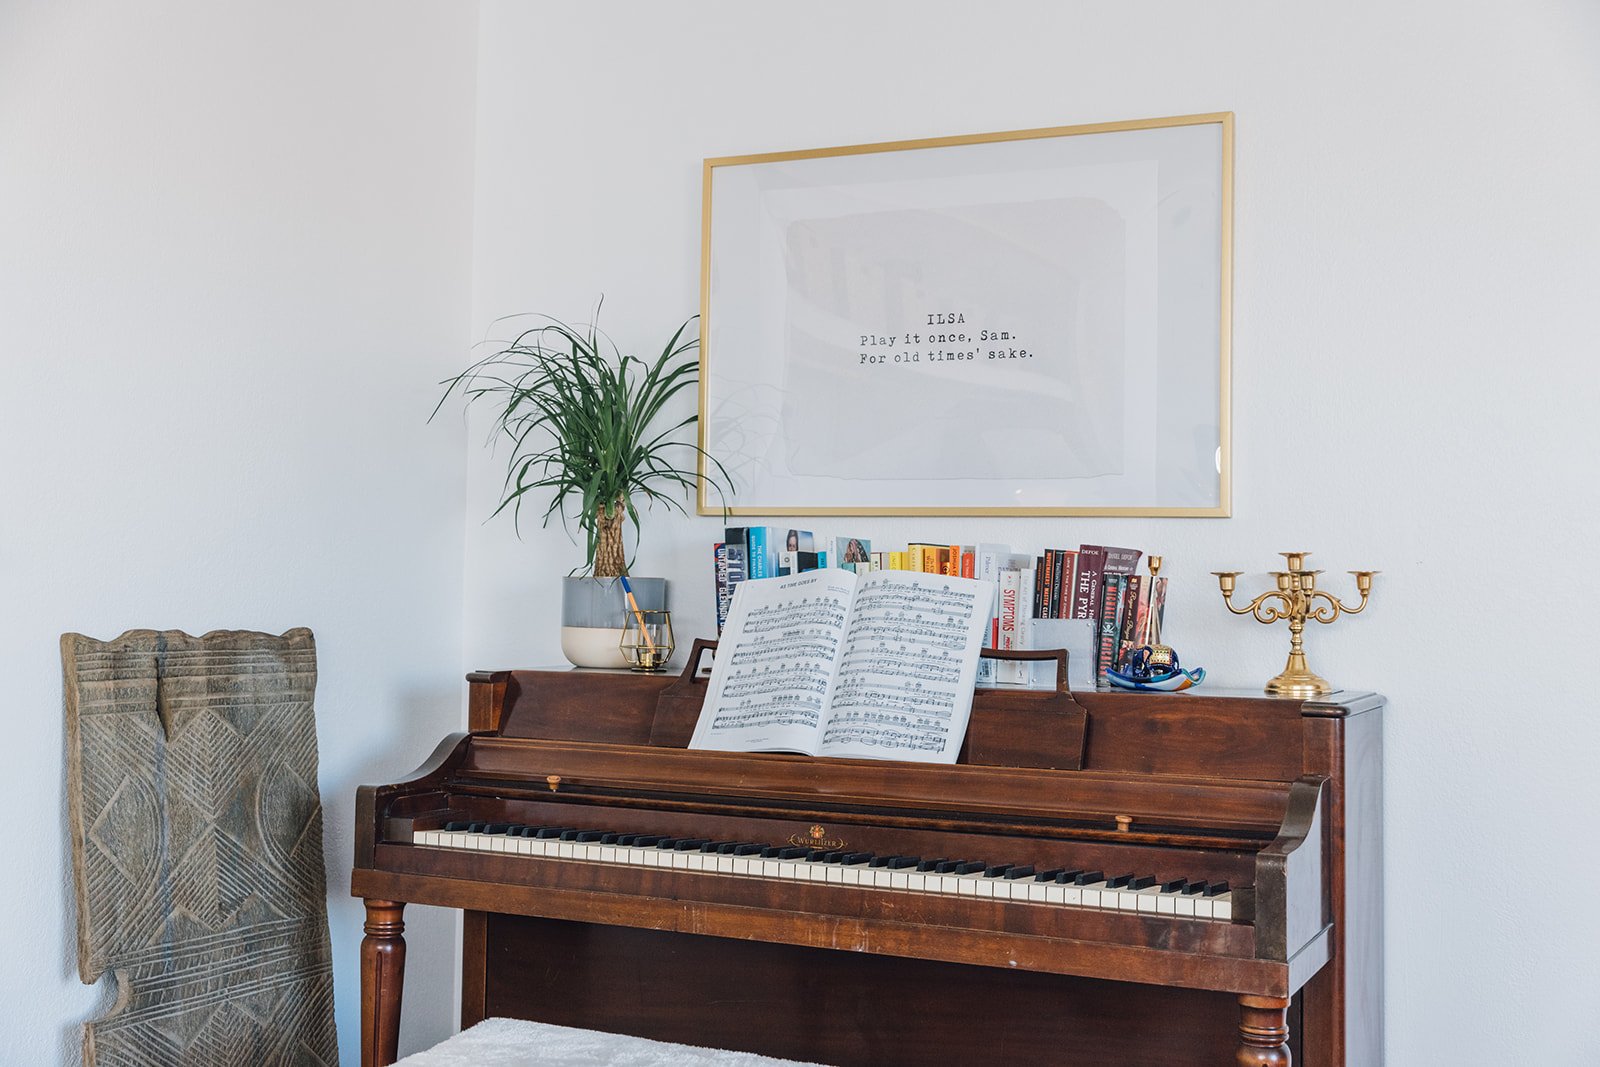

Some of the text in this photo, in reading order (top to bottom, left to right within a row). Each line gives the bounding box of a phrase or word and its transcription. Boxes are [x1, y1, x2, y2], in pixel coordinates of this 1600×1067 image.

[927, 313, 966, 325] ILSA
[860, 330, 1017, 347] Play it once, Sam.
[859, 348, 1034, 364] For old times' sake.
[717, 548, 727, 582] UNTAMED
[1079, 571, 1091, 594] THE
[719, 588, 728, 620] GLENNON
[1003, 589, 1016, 632] SYMPTOMS
[1103, 586, 1117, 619] MICHAEL
[1099, 637, 1114, 676] CRICHTON
[797, 836, 837, 847] WURLITZER
